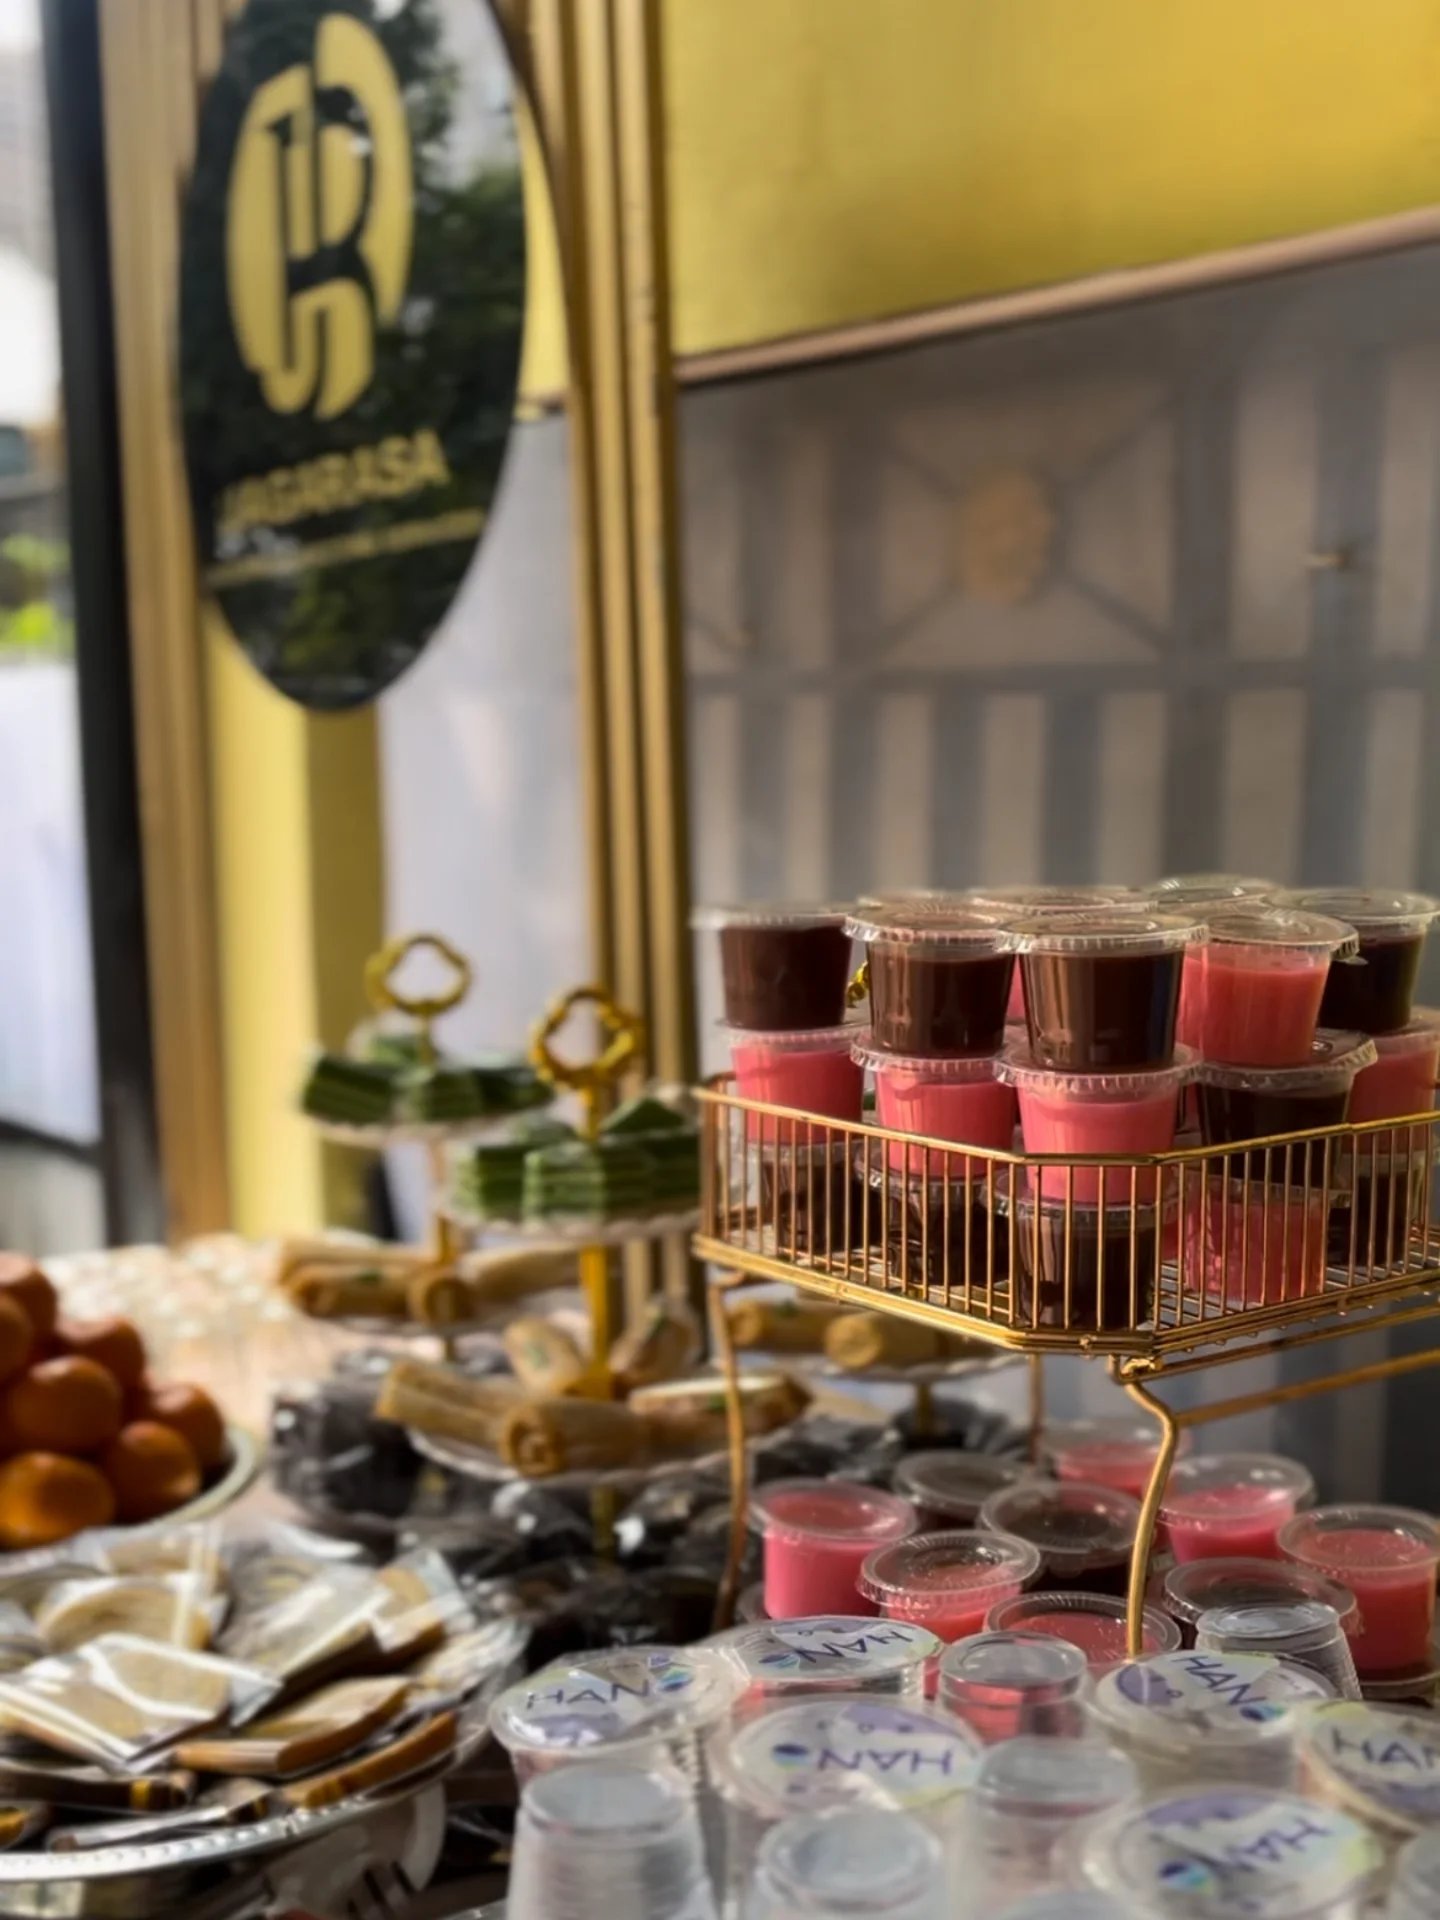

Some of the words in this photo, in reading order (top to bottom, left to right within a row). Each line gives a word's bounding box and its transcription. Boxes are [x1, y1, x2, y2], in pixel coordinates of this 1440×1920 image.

[794, 1630, 914, 1664] HAN
[525, 1679, 648, 1710] HAN
[1171, 1655, 1267, 1706] HAN
[817, 1749, 953, 1776] HAN
